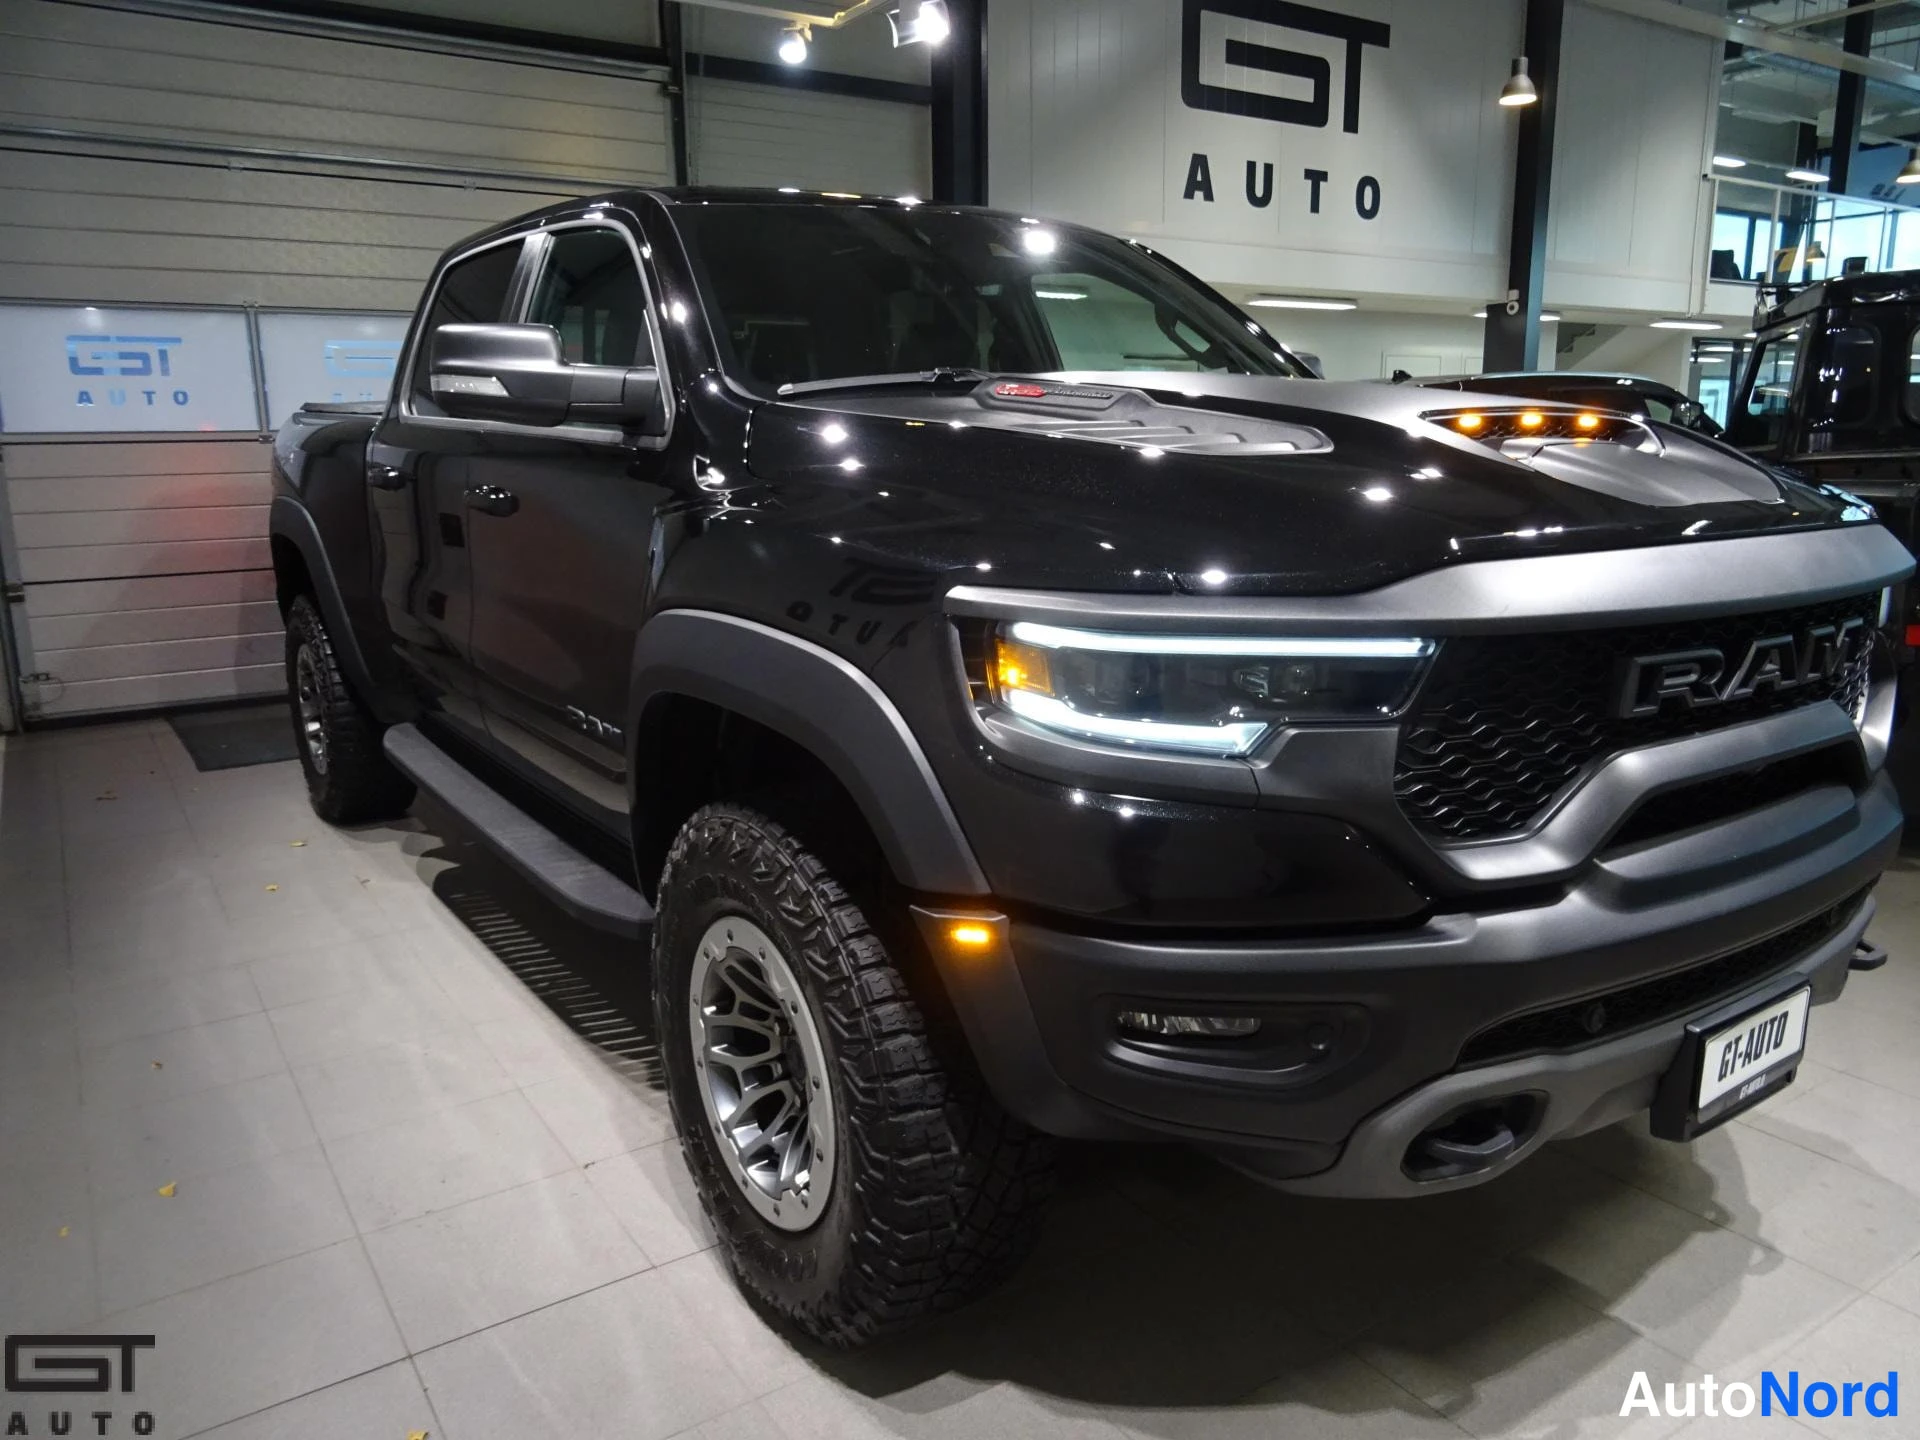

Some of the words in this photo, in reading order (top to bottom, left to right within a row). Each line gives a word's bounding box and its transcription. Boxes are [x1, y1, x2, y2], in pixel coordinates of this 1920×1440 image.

[1181, 0, 1390, 134] GT
[1183, 153, 1381, 220] AUTO
[76, 390, 190, 406] AUTO
[1619, 616, 1864, 719] RAM
[1717, 1010, 1789, 1082] GT-AUTO
